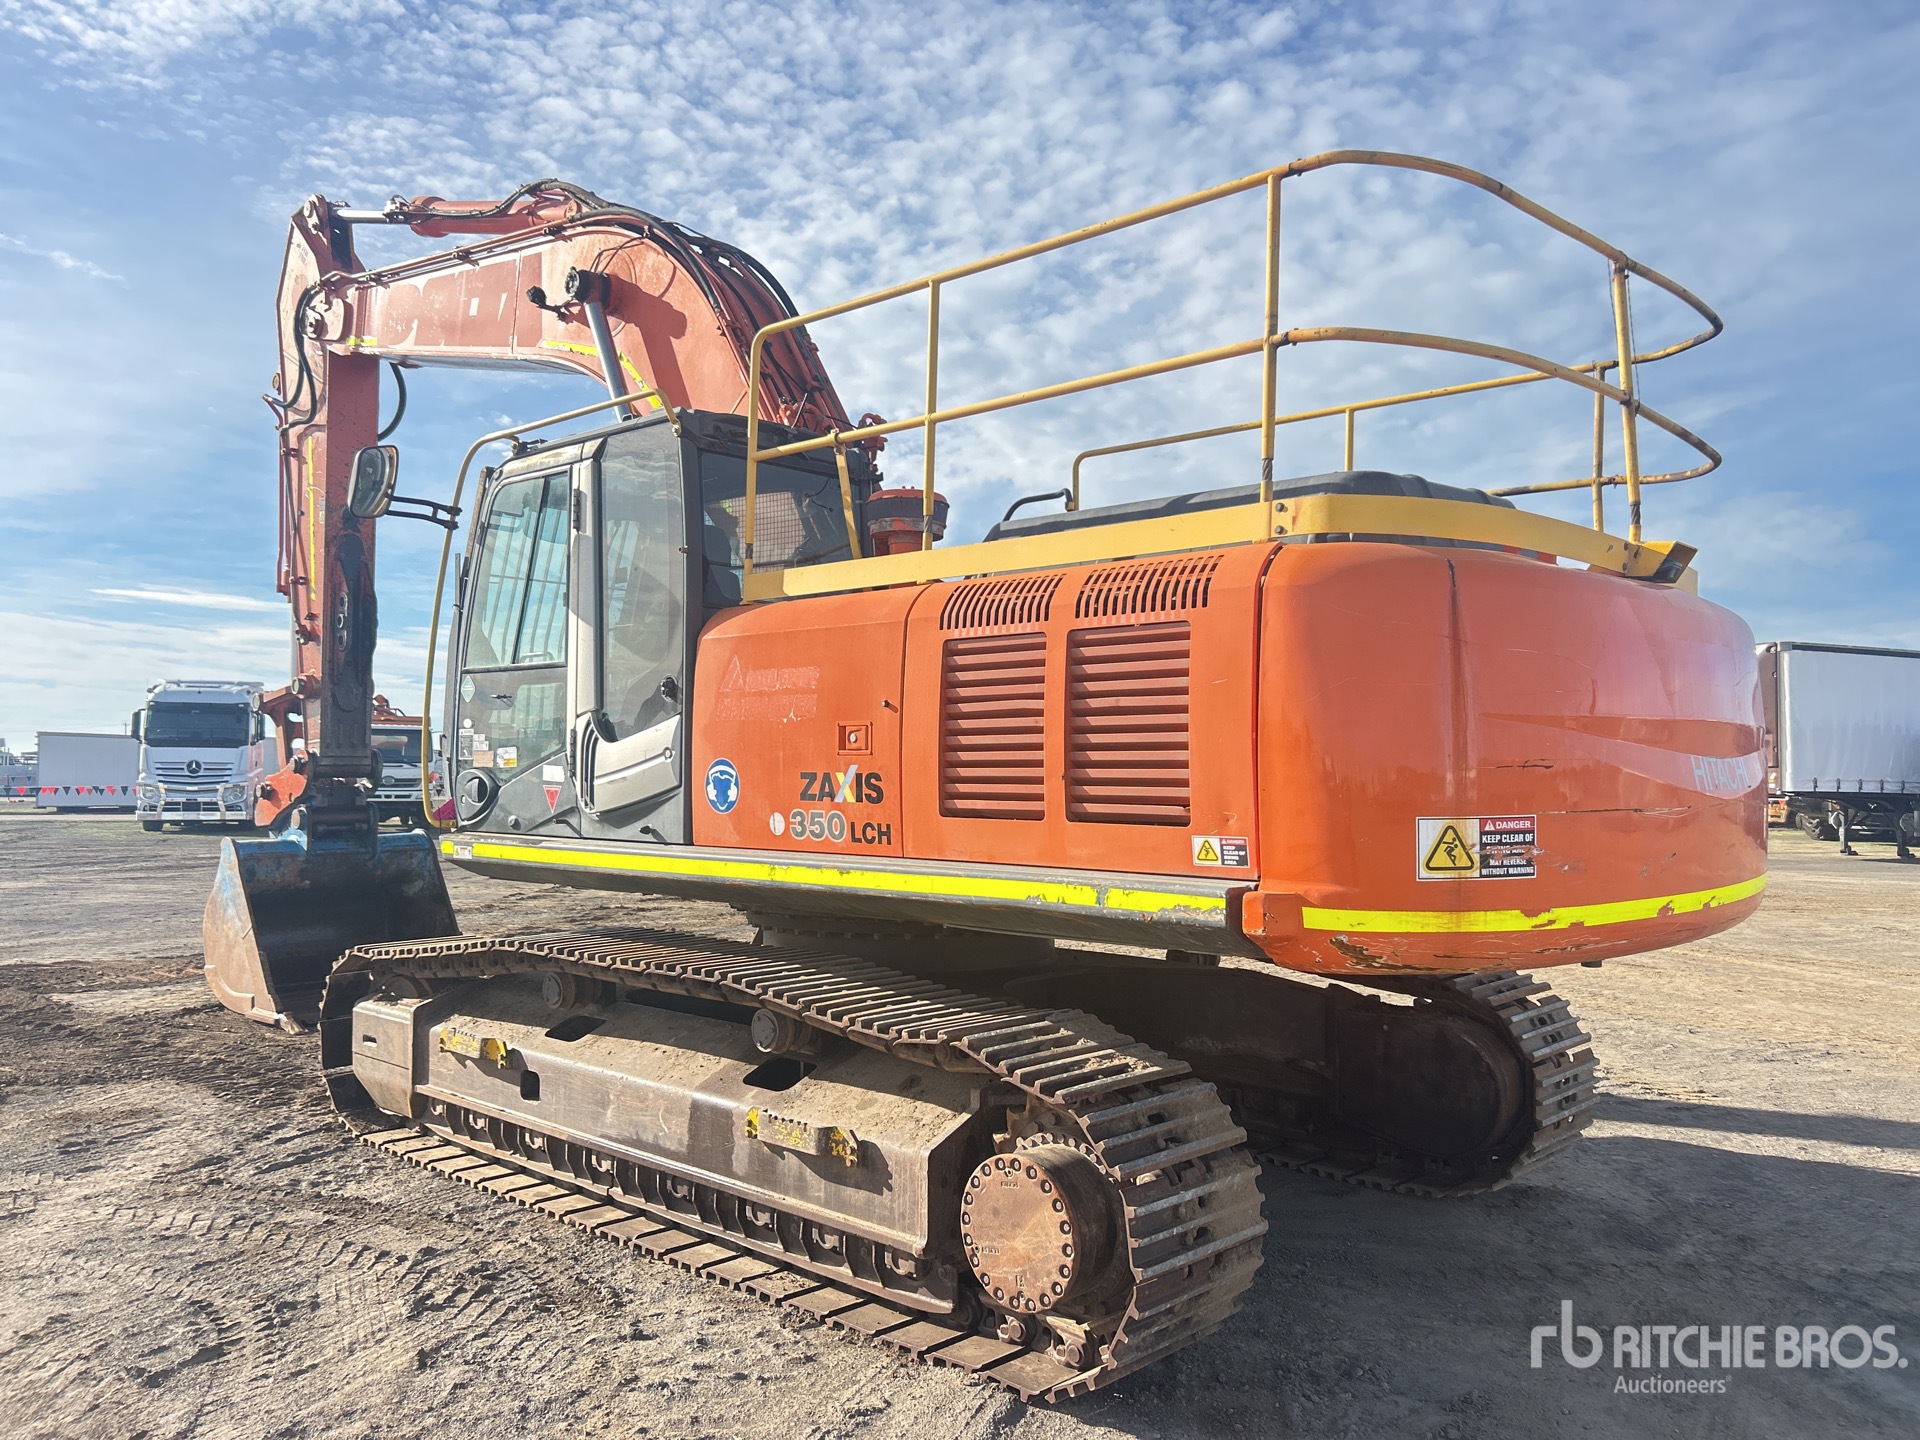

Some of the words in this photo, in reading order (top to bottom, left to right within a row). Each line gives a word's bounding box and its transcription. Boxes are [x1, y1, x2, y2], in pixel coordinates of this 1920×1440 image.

[799, 764, 885, 805] ZAXIS
[789, 808, 847, 843] 350
[850, 821, 892, 845] LCH
[1496, 821, 1531, 829] DANGER
[1482, 835, 1500, 843] KEEP
[1502, 834, 1524, 842] CLEAR
[1525, 834, 1533, 842] OF
